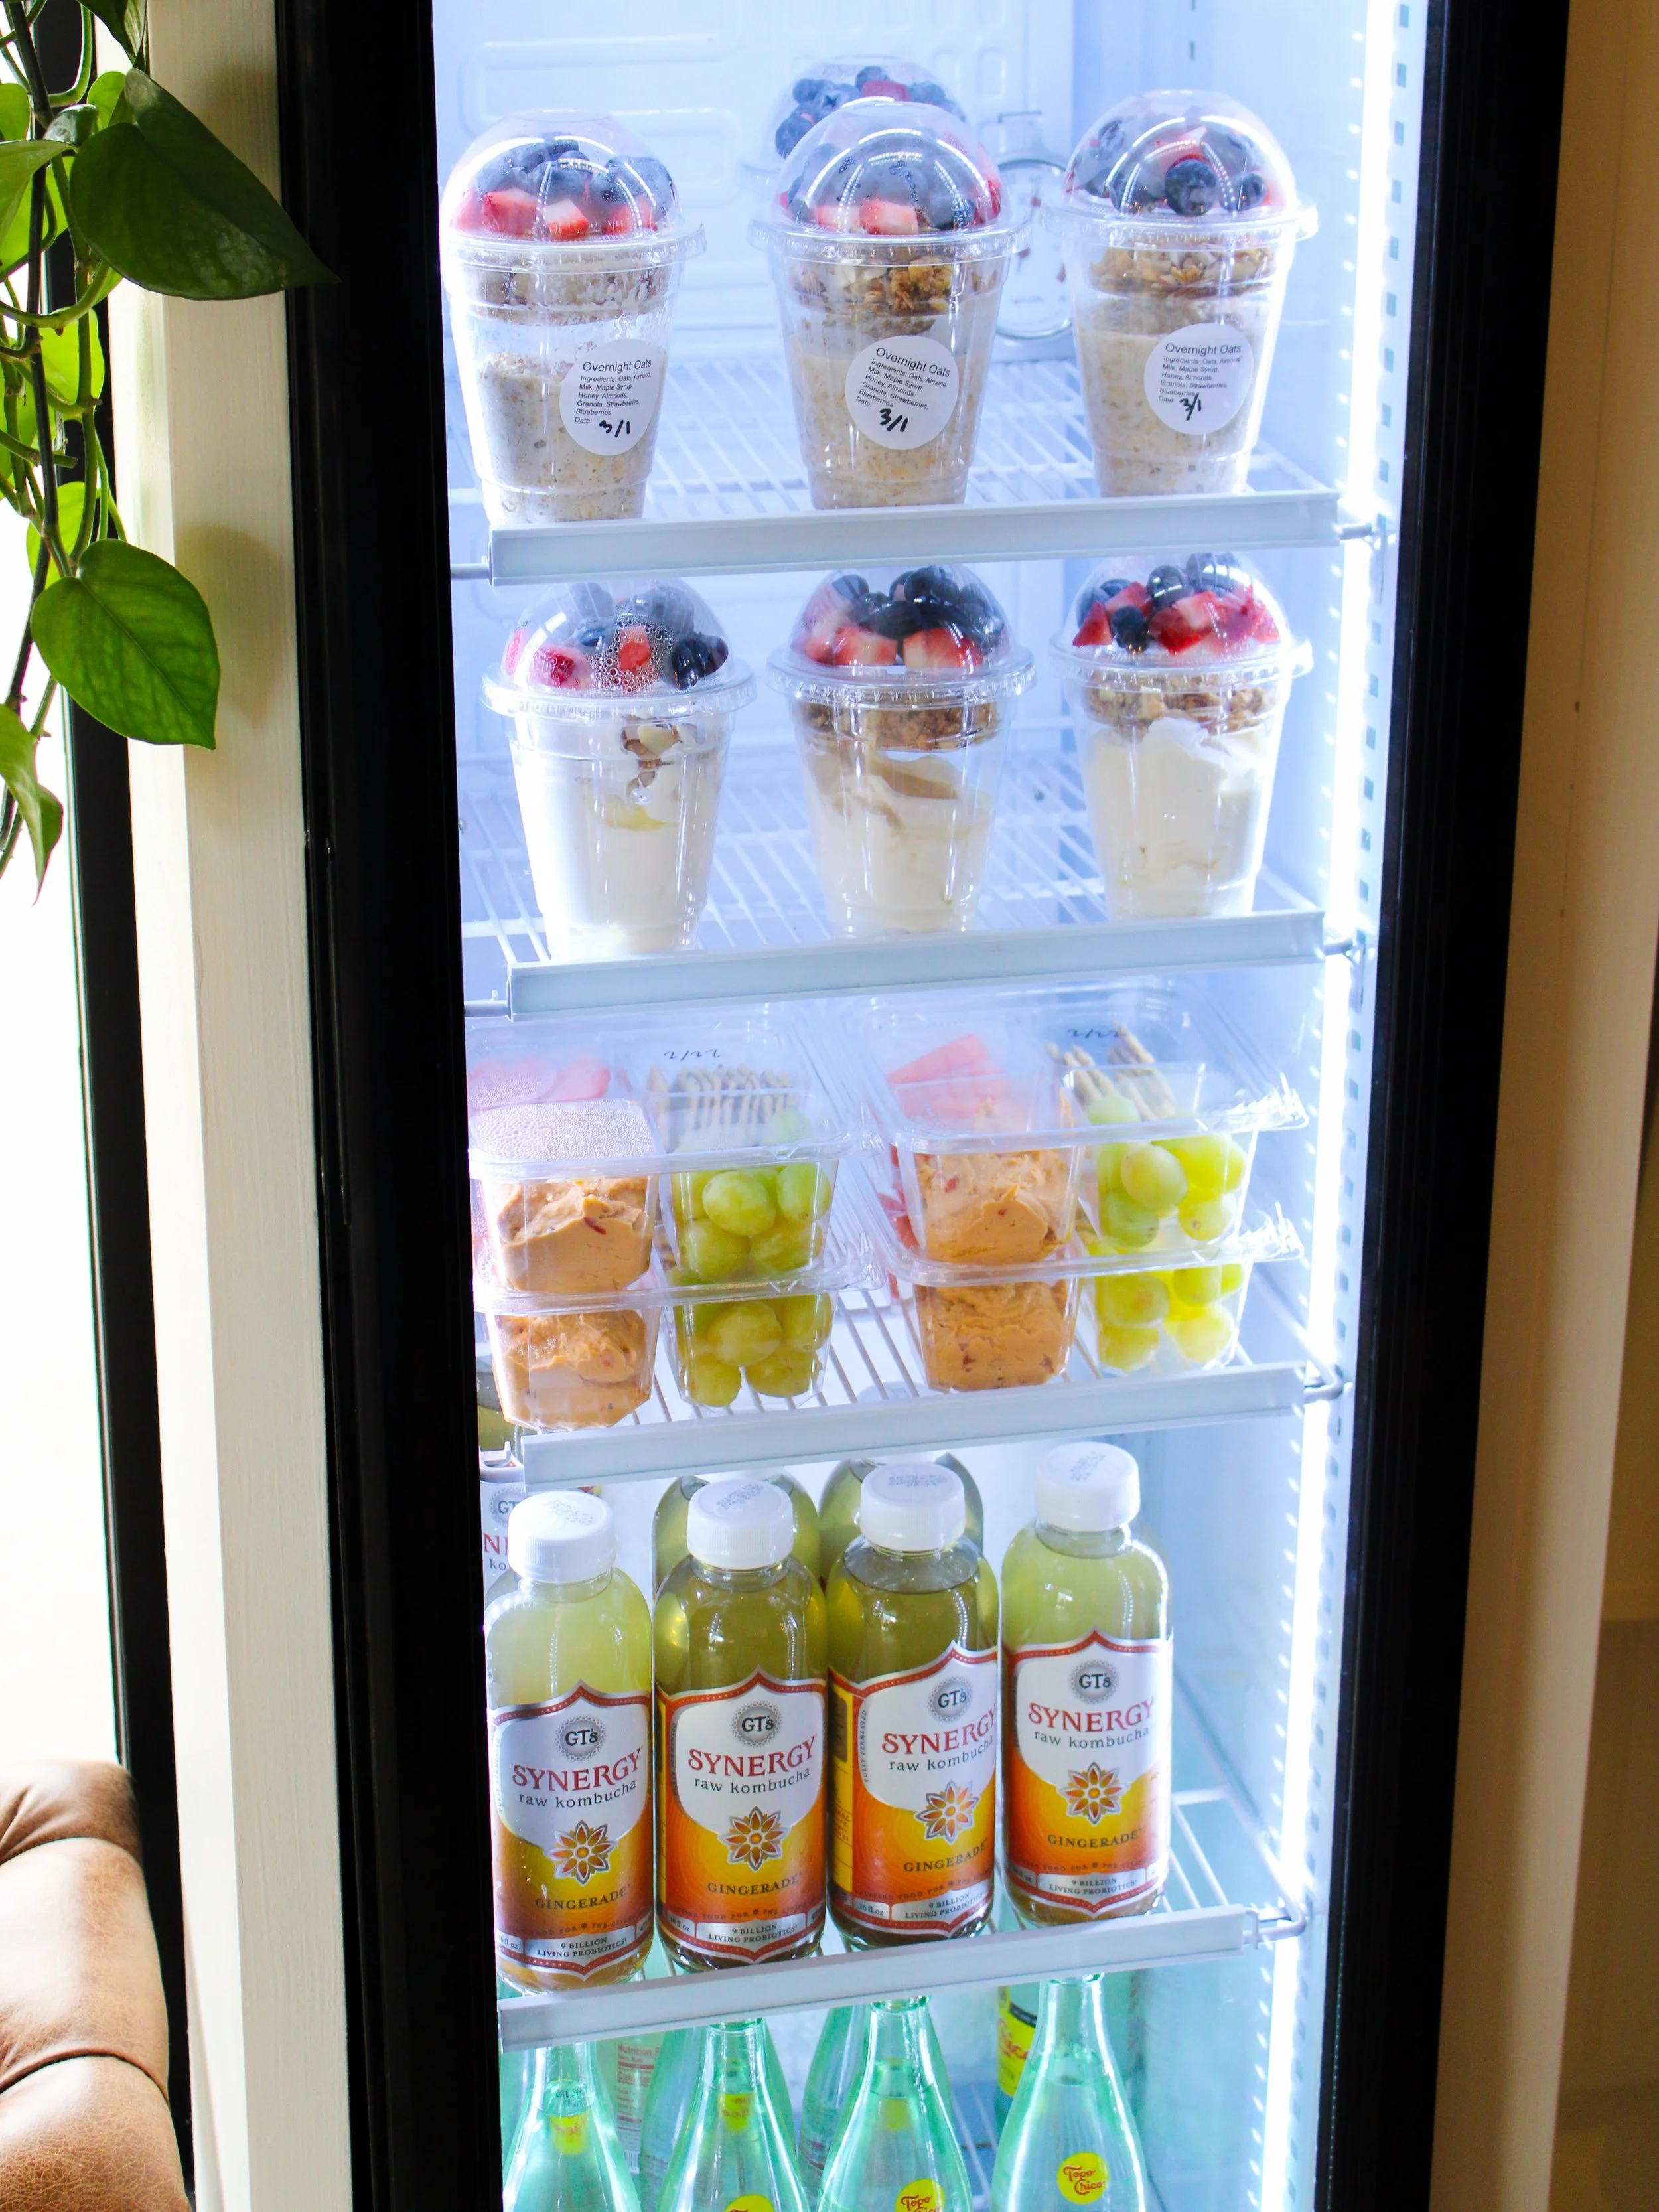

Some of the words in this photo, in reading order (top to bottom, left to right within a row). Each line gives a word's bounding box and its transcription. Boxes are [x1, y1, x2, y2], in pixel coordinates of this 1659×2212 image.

[1165, 343, 1217, 357] Overnight
[1220, 344, 1242, 354] Oats
[583, 362, 632, 374] Overnight
[634, 359, 652, 370] Oats
[876, 347, 926, 372] Overnight
[929, 364, 951, 378] Oats
[634, 372, 650, 380] Almond
[867, 366, 883, 377] Milk,
[883, 373, 903, 384] Maple
[904, 380, 923, 392] Syrup,
[908, 372, 924, 383] Oats,
[925, 378, 947, 388] Almond
[859, 389, 893, 407] Blueberries
[862, 382, 888, 398] Granola,
[890, 394, 928, 410] Strawberries,
[888, 384, 916, 398] Almonds,
[1159, 388, 1195, 396] Blueberries
[1179, 392, 1202, 421] 3/1
[599, 419, 630, 438] 3/1
[879, 408, 908, 432] 3/1
[1028, 1696, 1154, 1733] SYNERGY
[741, 1715, 774, 1733] GT's
[858, 1710, 867, 1755] FERMENTED
[882, 1709, 996, 1755] SYNERGY
[565, 1728, 599, 1746] GT's
[1035, 1731, 1062, 1746] raw
[1069, 1726, 1149, 1749] kombucha
[687, 1734, 816, 1778] SYNERGY
[889, 1760, 920, 1771] raw
[928, 1735, 993, 1771] kombucha
[512, 1747, 641, 1792] SYNERGY
[858, 1757, 869, 1783] FULLY
[694, 1778, 723, 1792] raw
[731, 1767, 810, 1794] kombucha
[519, 1793, 548, 1807] raw
[555, 1779, 636, 1808] kombucha
[1048, 1830, 1138, 1848] GINGERADE
[903, 1844, 986, 1872] GINGERADE
[707, 1876, 799, 1895] GINGERADE
[1049, 1884, 1080, 1895] LIVING
[1080, 1878, 1117, 1887] BILLION
[534, 1887, 627, 1910] GINGERADE
[936, 1893, 970, 1909] BILLION
[740, 1924, 777, 1934] BILLION
[569, 1937, 607, 1949] BILLION
[709, 1934, 741, 1943] LIVING
[1063, 2166, 1096, 2181] Topo
[1074, 2179, 1106, 2195] Chico
[901, 2193, 933, 2211] Topo
